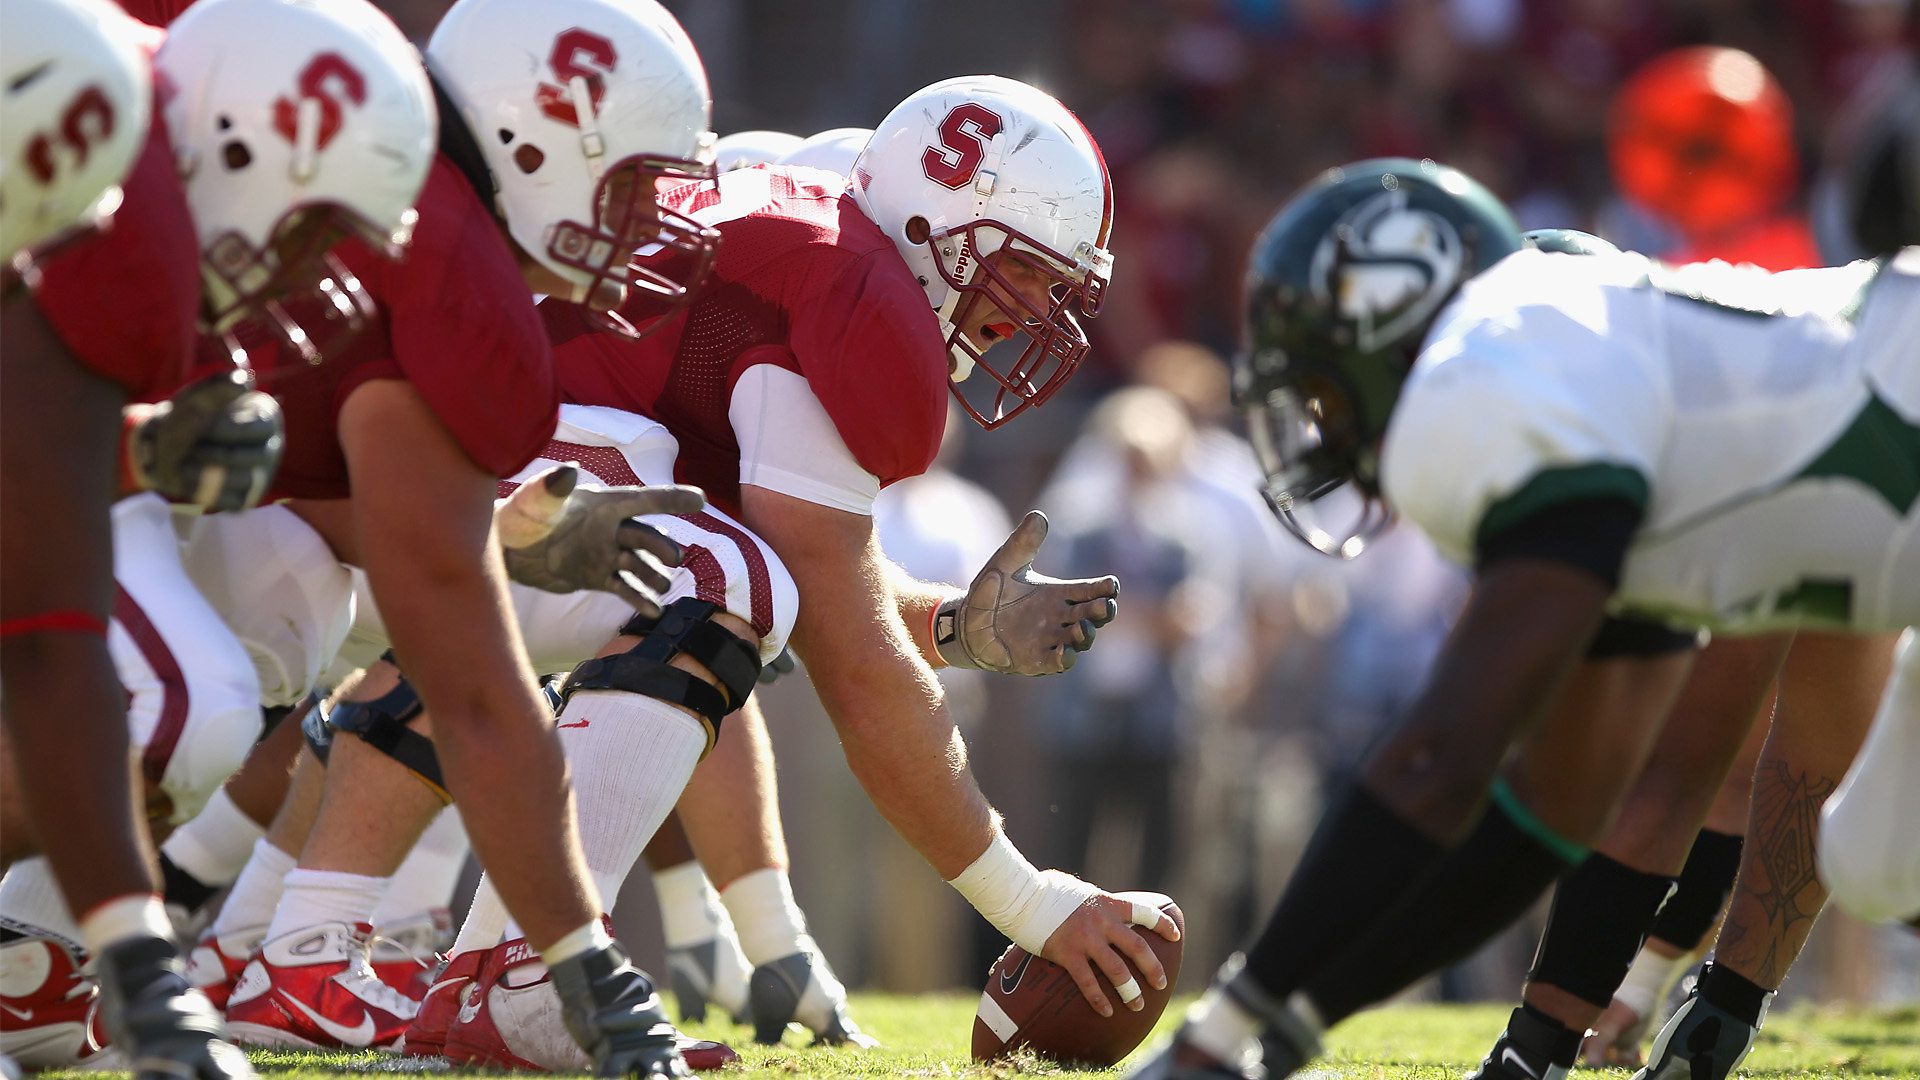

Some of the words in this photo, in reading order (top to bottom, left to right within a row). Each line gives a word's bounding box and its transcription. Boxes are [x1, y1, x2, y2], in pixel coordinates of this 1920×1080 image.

[271, 51, 367, 153] S
[534, 27, 617, 128] S
[24, 83, 114, 184] S
[921, 102, 1003, 191] S
